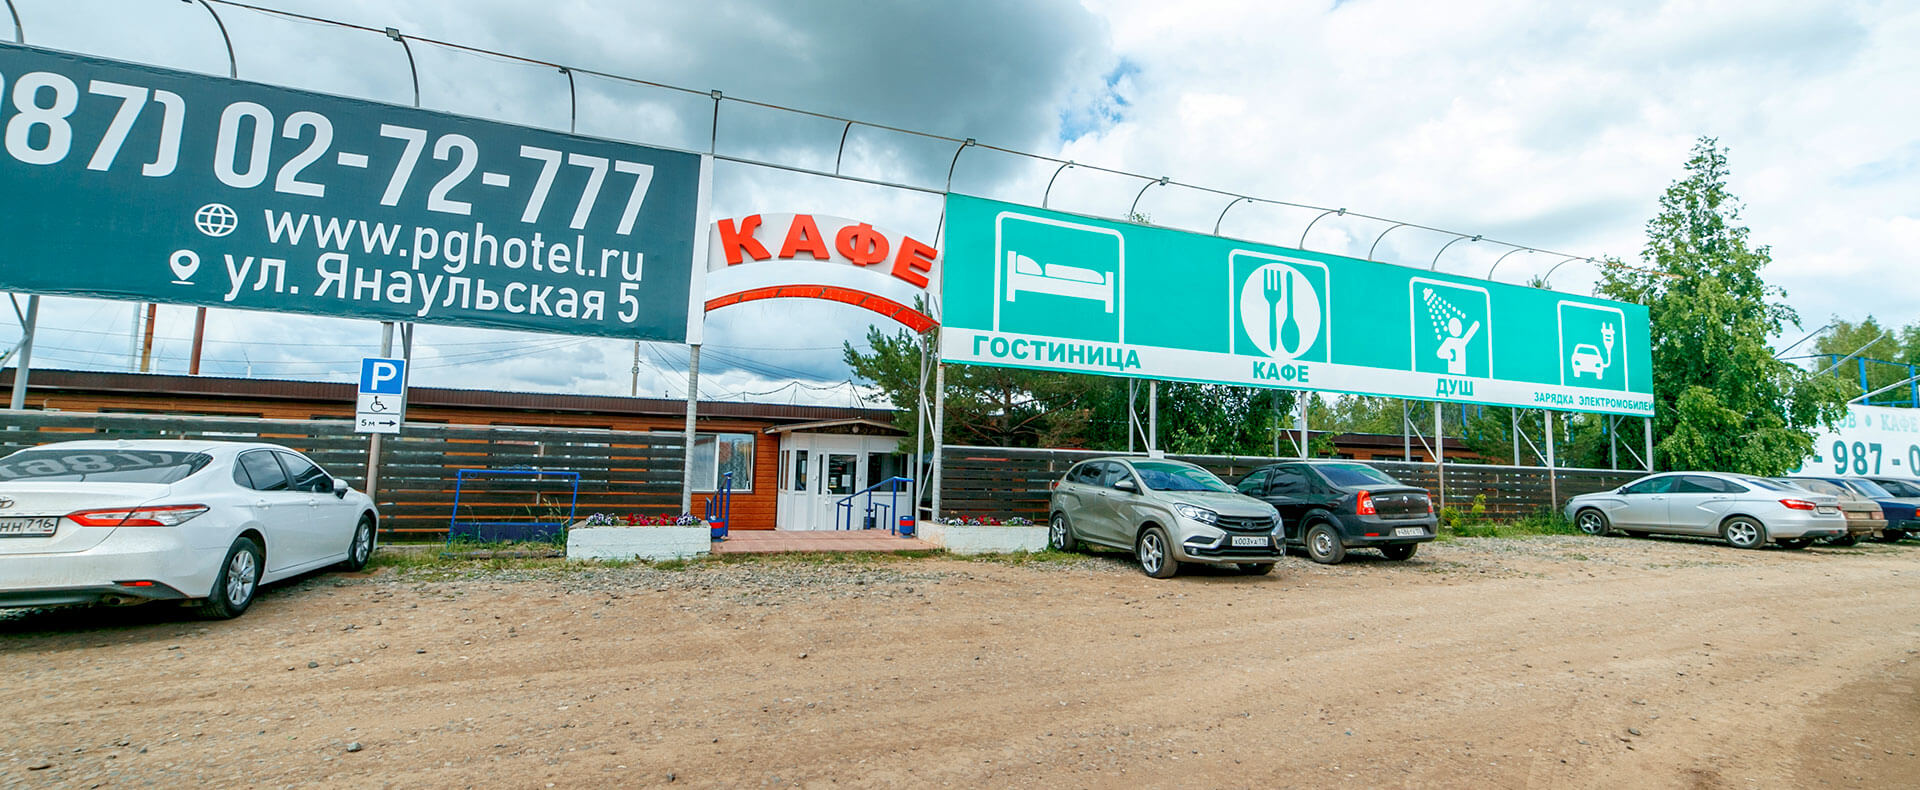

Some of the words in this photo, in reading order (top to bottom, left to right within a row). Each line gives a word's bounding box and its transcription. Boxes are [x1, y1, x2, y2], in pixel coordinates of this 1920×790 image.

[0, 71, 187, 178] 87)
[213, 100, 655, 236] 02-72-777
[264, 208, 644, 282] www.pghotel.ru
[717, 213, 938, 290] КАФЕ
[223, 253, 299, 302] ул.
[313, 252, 606, 321] Янаульская
[617, 282, 640, 323] 5
[972, 335, 1142, 371] ГОСТИНИЦА
[371, 361, 397, 391] P
[1252, 360, 1310, 383] КАФЕ
[1436, 378, 1474, 397] ДУШ
[1534, 391, 1574, 406] ЗАРЯДКА
